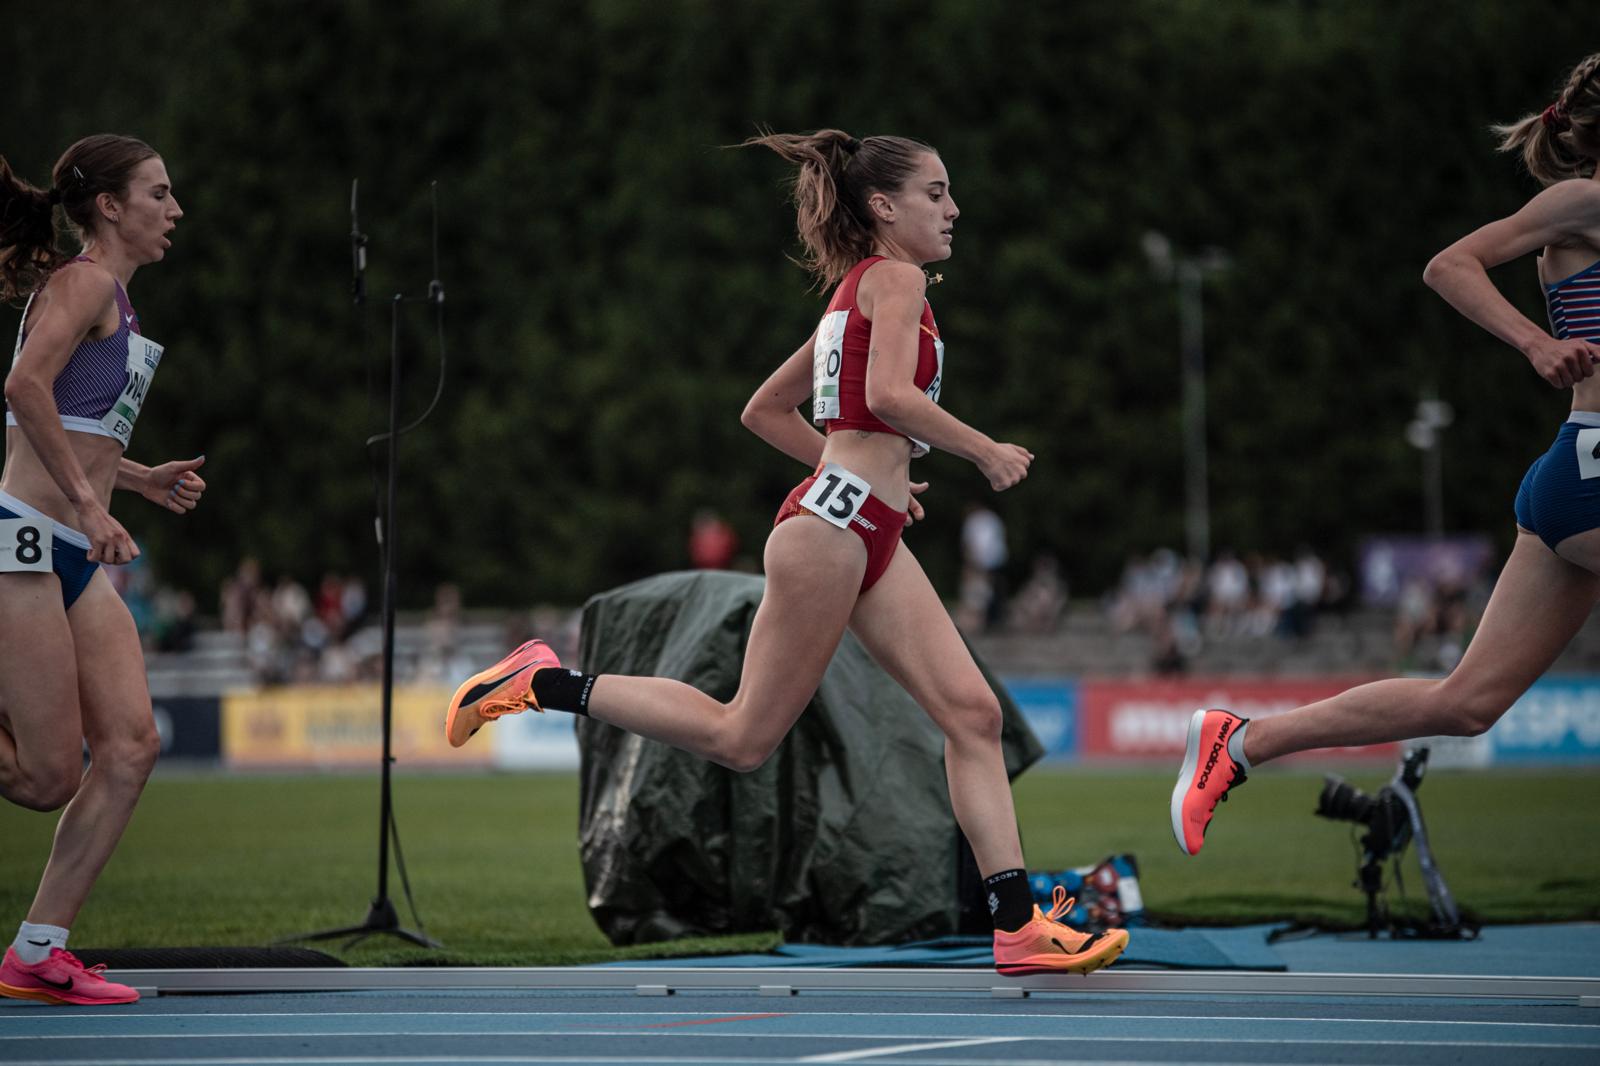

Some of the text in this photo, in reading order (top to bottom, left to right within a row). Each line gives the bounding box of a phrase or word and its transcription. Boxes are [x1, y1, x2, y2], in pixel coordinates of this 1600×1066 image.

[815, 473, 863, 520] 15
[15, 526, 42, 564] 8
[1197, 717, 1233, 790] new balance
